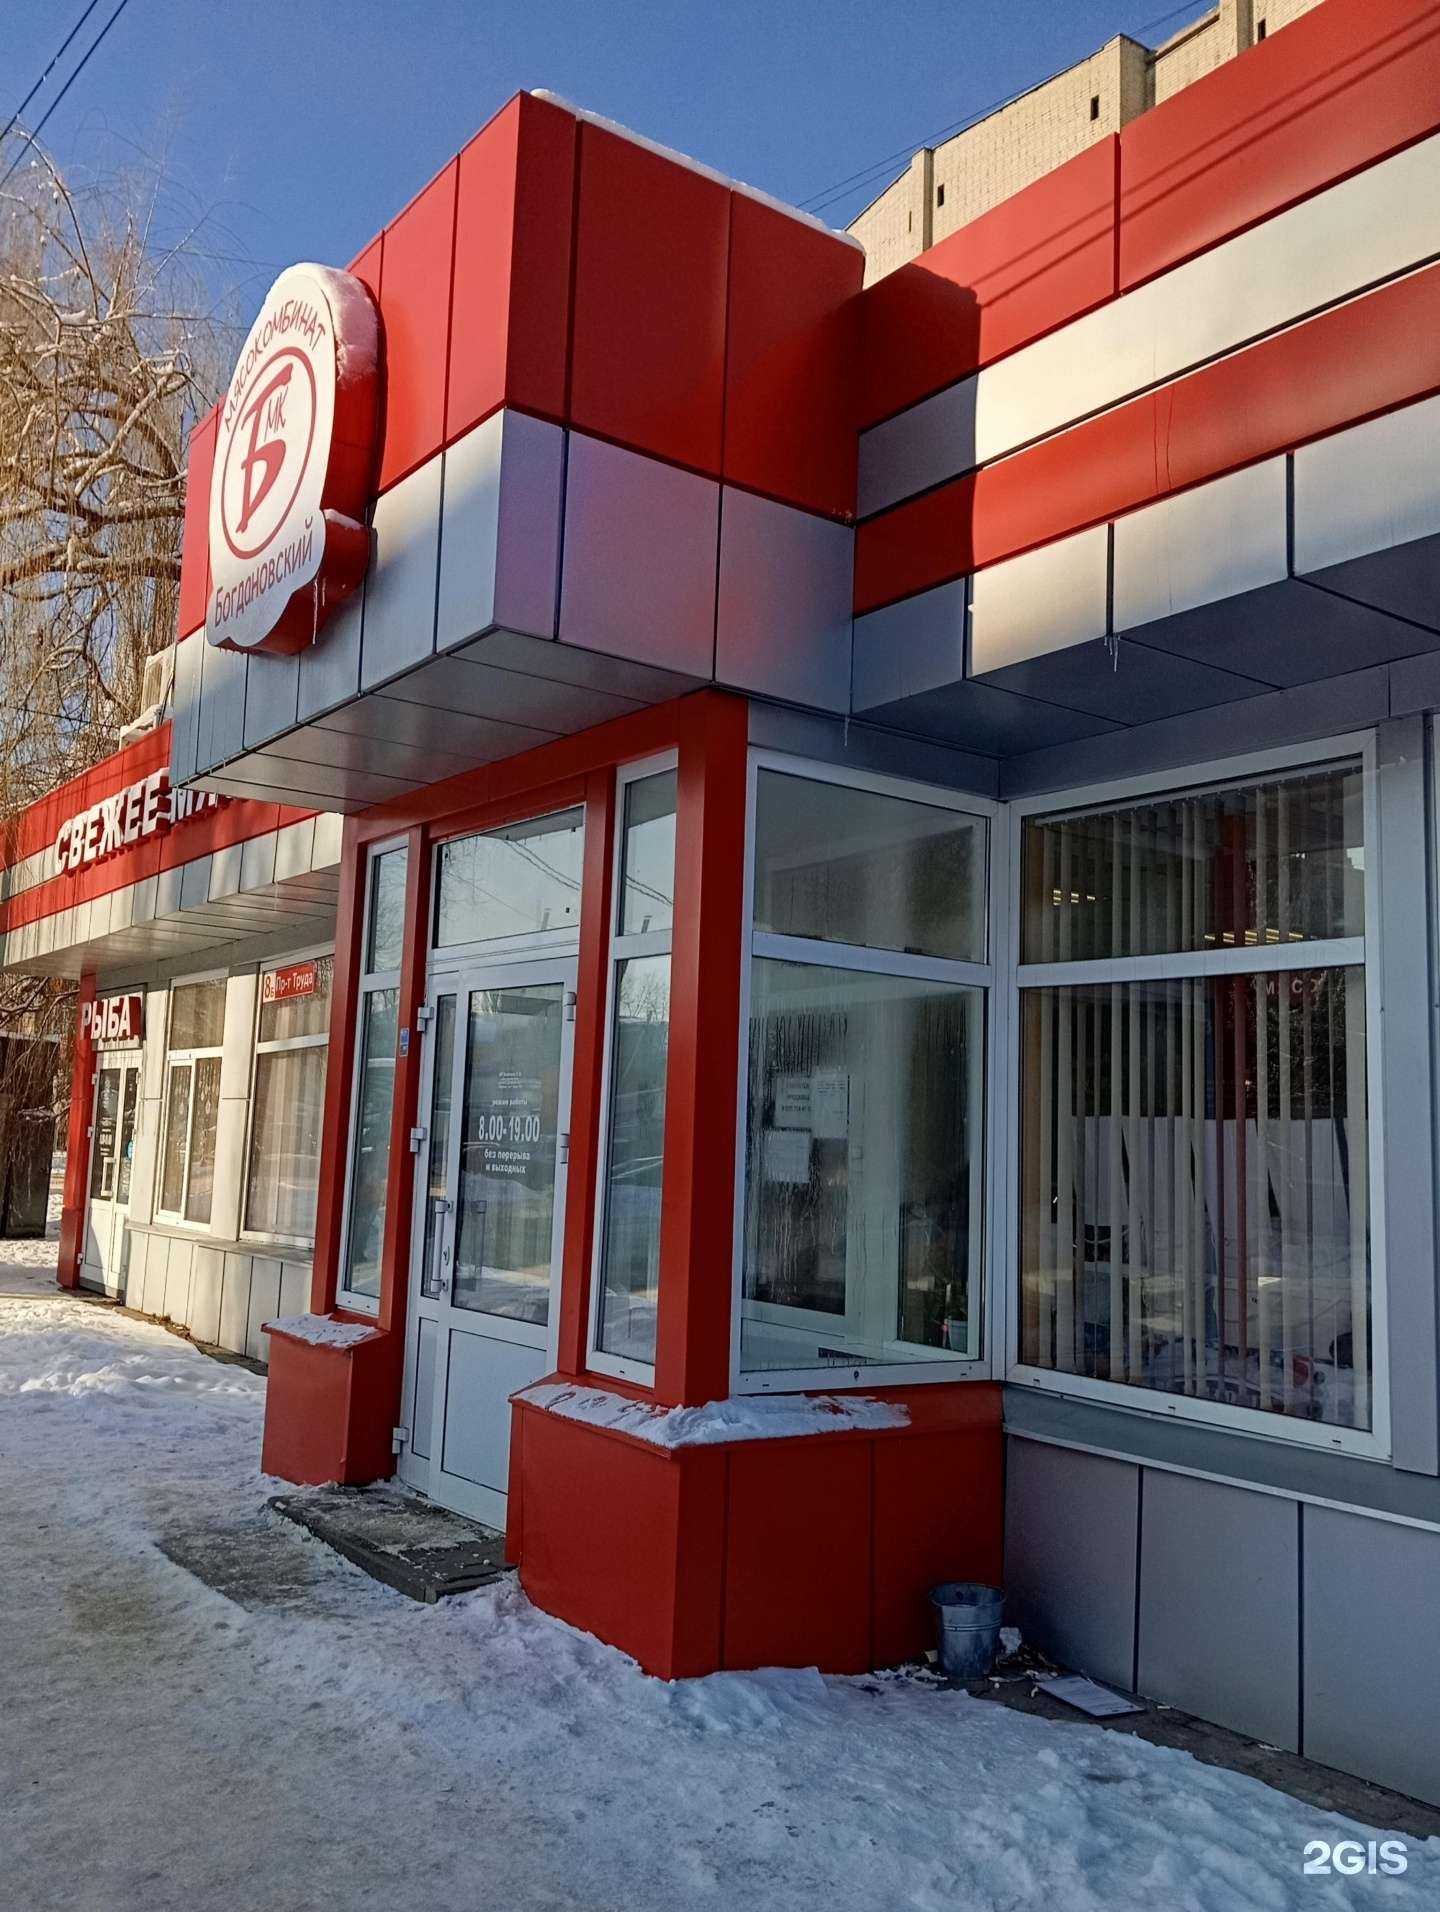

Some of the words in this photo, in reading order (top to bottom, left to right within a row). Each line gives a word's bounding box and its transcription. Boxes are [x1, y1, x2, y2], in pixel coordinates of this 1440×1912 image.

[225, 300, 325, 432] МЯСОКОМБИНАТ
[55, 767, 168, 874] СВЕЖЕЕ
[293, 972, 313, 991] Труда
[82, 995, 131, 1040] РЫБА
[484, 1148, 496, 1159] без
[498, 1151, 530, 1162] перерыва
[492, 1164, 527, 1174] выходных
